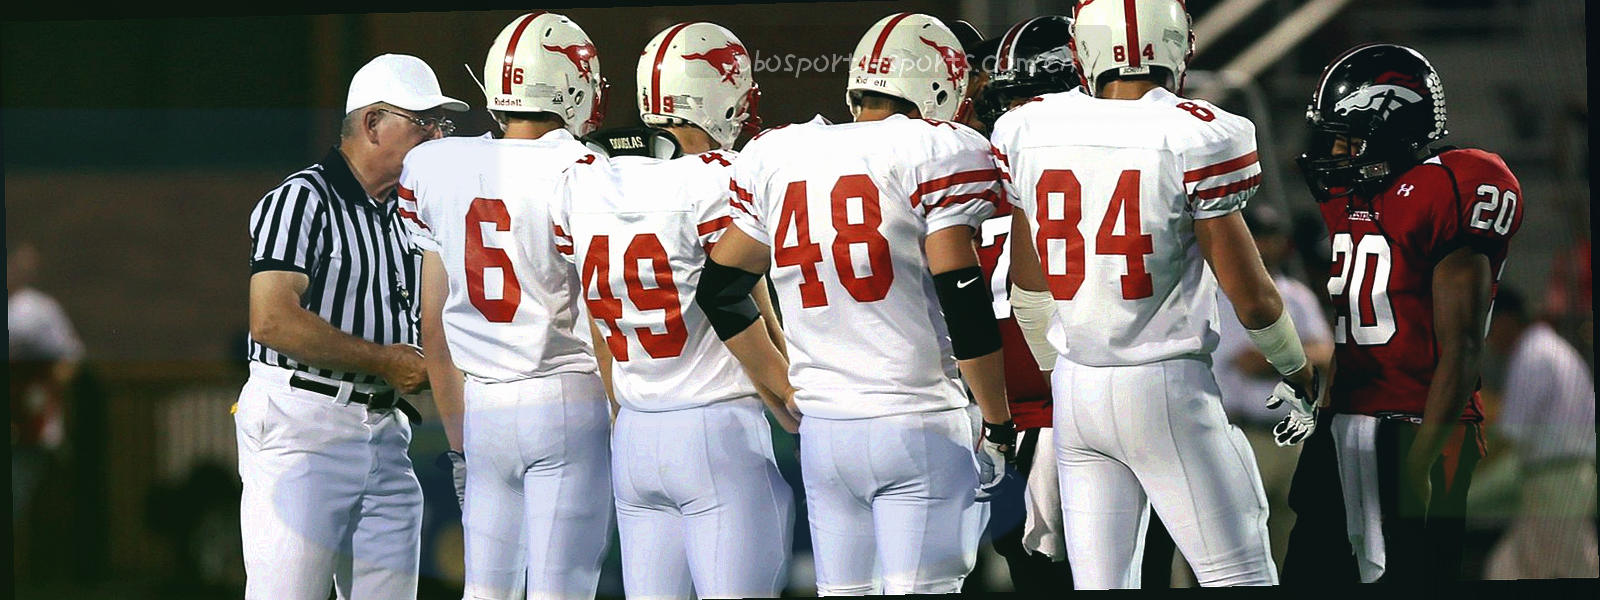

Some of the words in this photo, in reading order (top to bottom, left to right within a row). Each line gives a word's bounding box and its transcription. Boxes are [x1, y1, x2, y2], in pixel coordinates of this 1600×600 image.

[513, 67, 525, 85] 6
[464, 197, 522, 323] 6
[774, 173, 895, 309] 48
[1035, 169, 1154, 301] 84
[1470, 184, 1517, 236] 20
[582, 233, 689, 362] 49
[1326, 232, 1397, 345] 20
